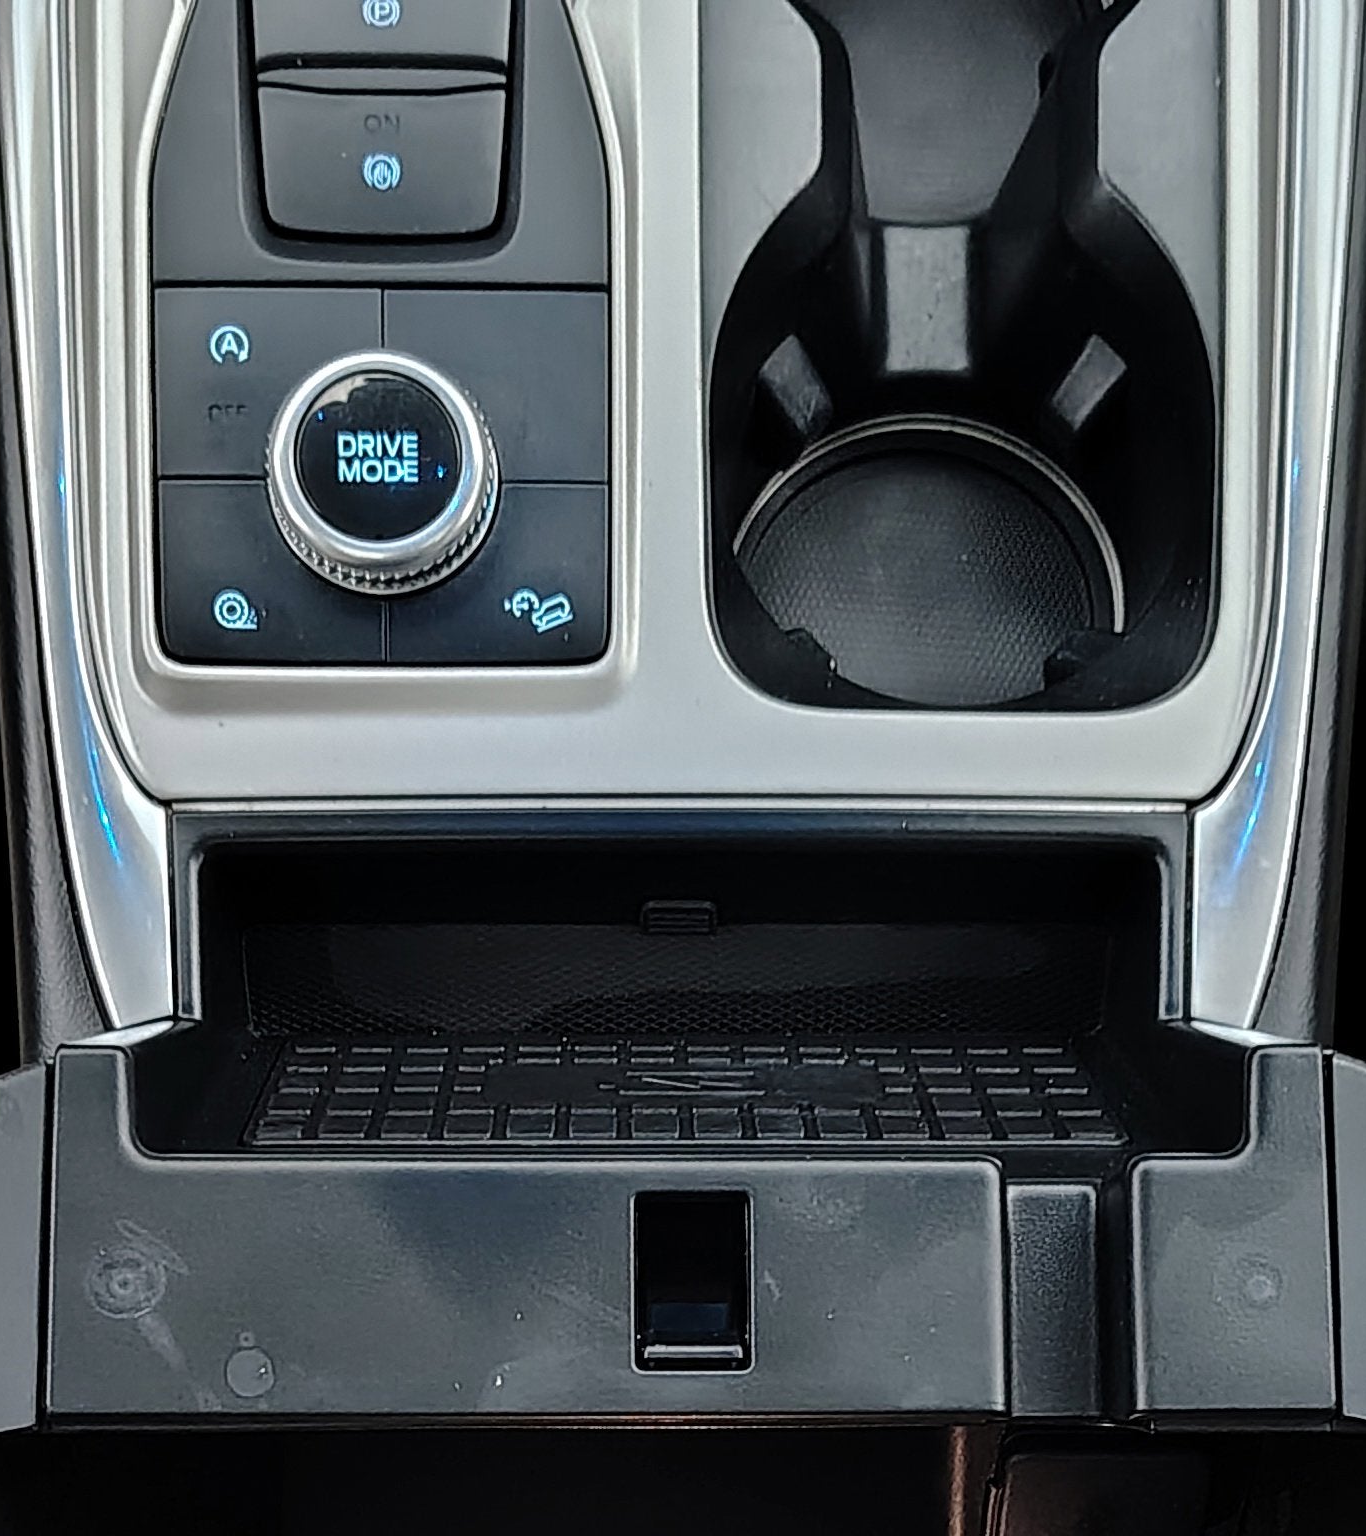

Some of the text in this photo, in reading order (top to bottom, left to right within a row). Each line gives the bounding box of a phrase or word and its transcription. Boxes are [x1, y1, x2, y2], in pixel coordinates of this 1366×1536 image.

[364, 113, 401, 134] ON
[220, 332, 239, 355] A
[337, 430, 419, 457] DRIVE
[337, 458, 419, 483] MODE
